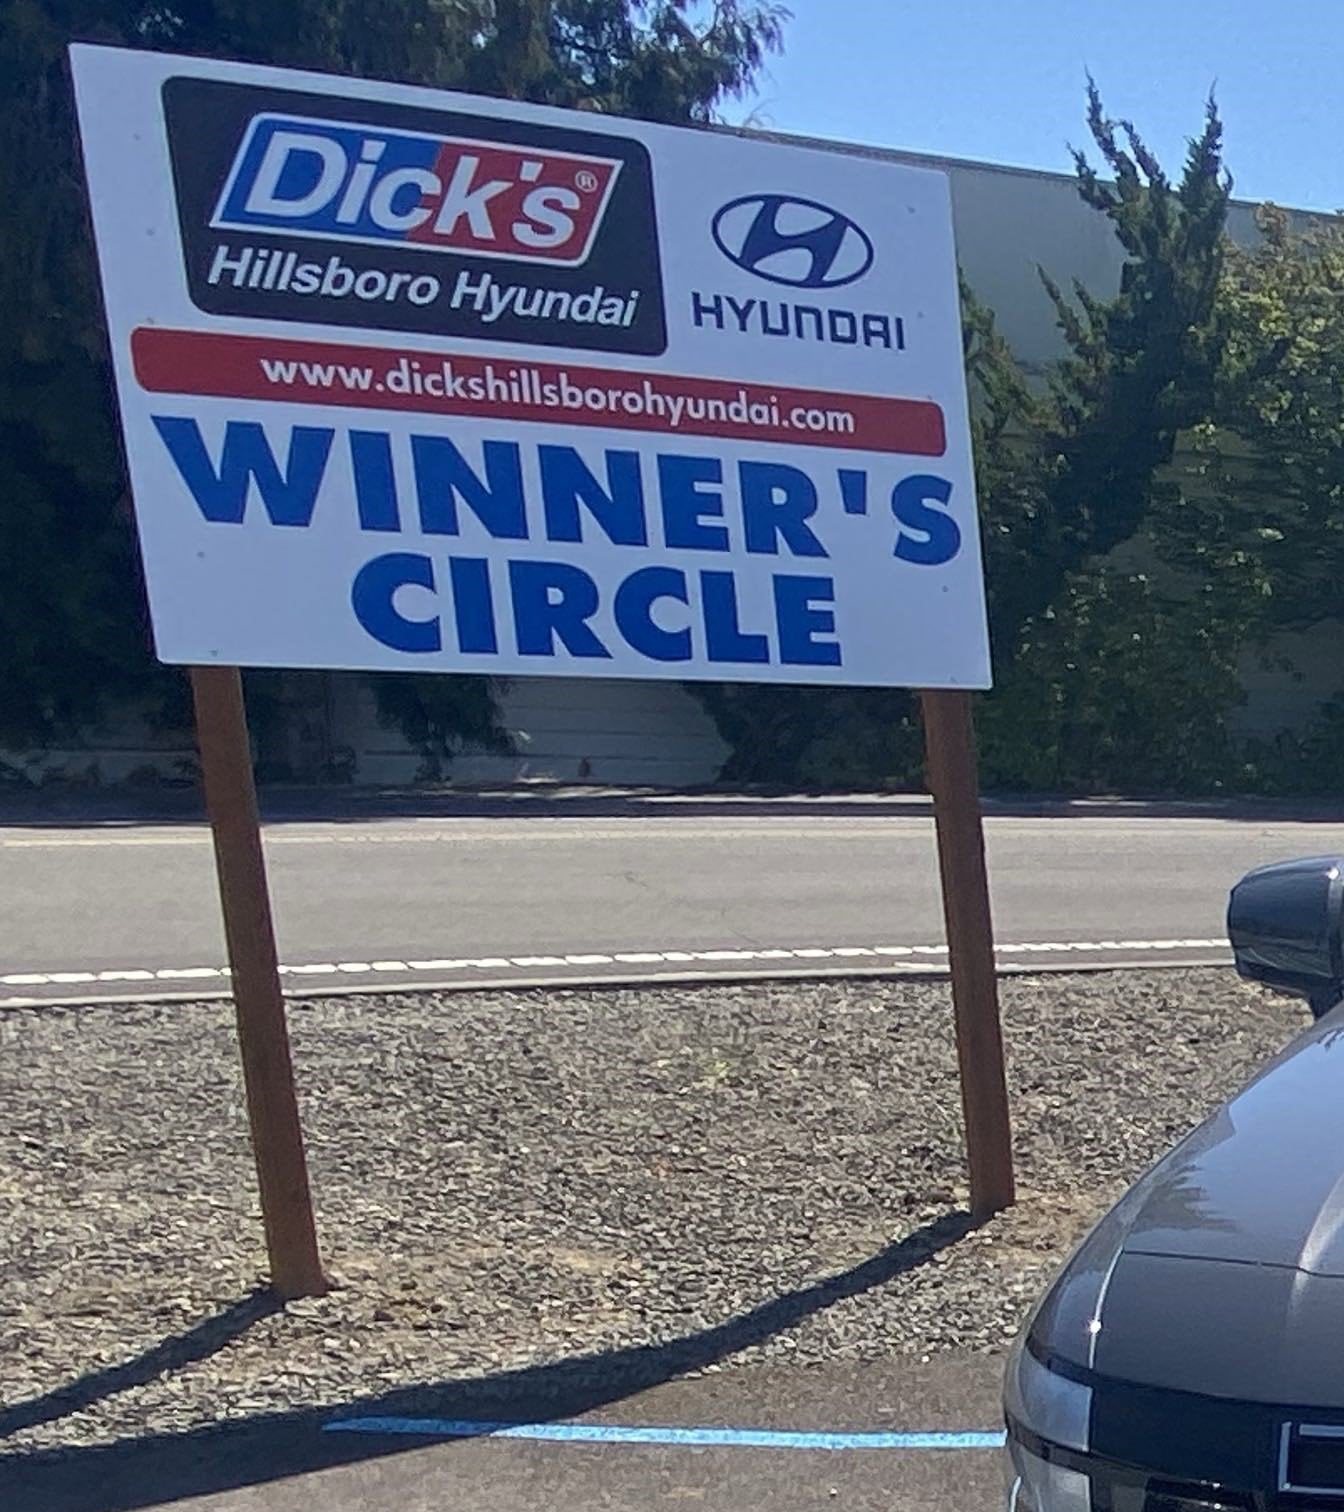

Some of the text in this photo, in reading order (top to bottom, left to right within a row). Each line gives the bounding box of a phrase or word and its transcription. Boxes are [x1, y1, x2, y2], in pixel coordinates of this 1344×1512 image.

[208, 246, 638, 329] Hillsboro Hyundai
[691, 293, 905, 351] HYUNDAI
[261, 355, 855, 435] www.dickshillsborohyundai.com
[152, 414, 962, 567] WINNER'S
[351, 552, 844, 668] CIRCLE
